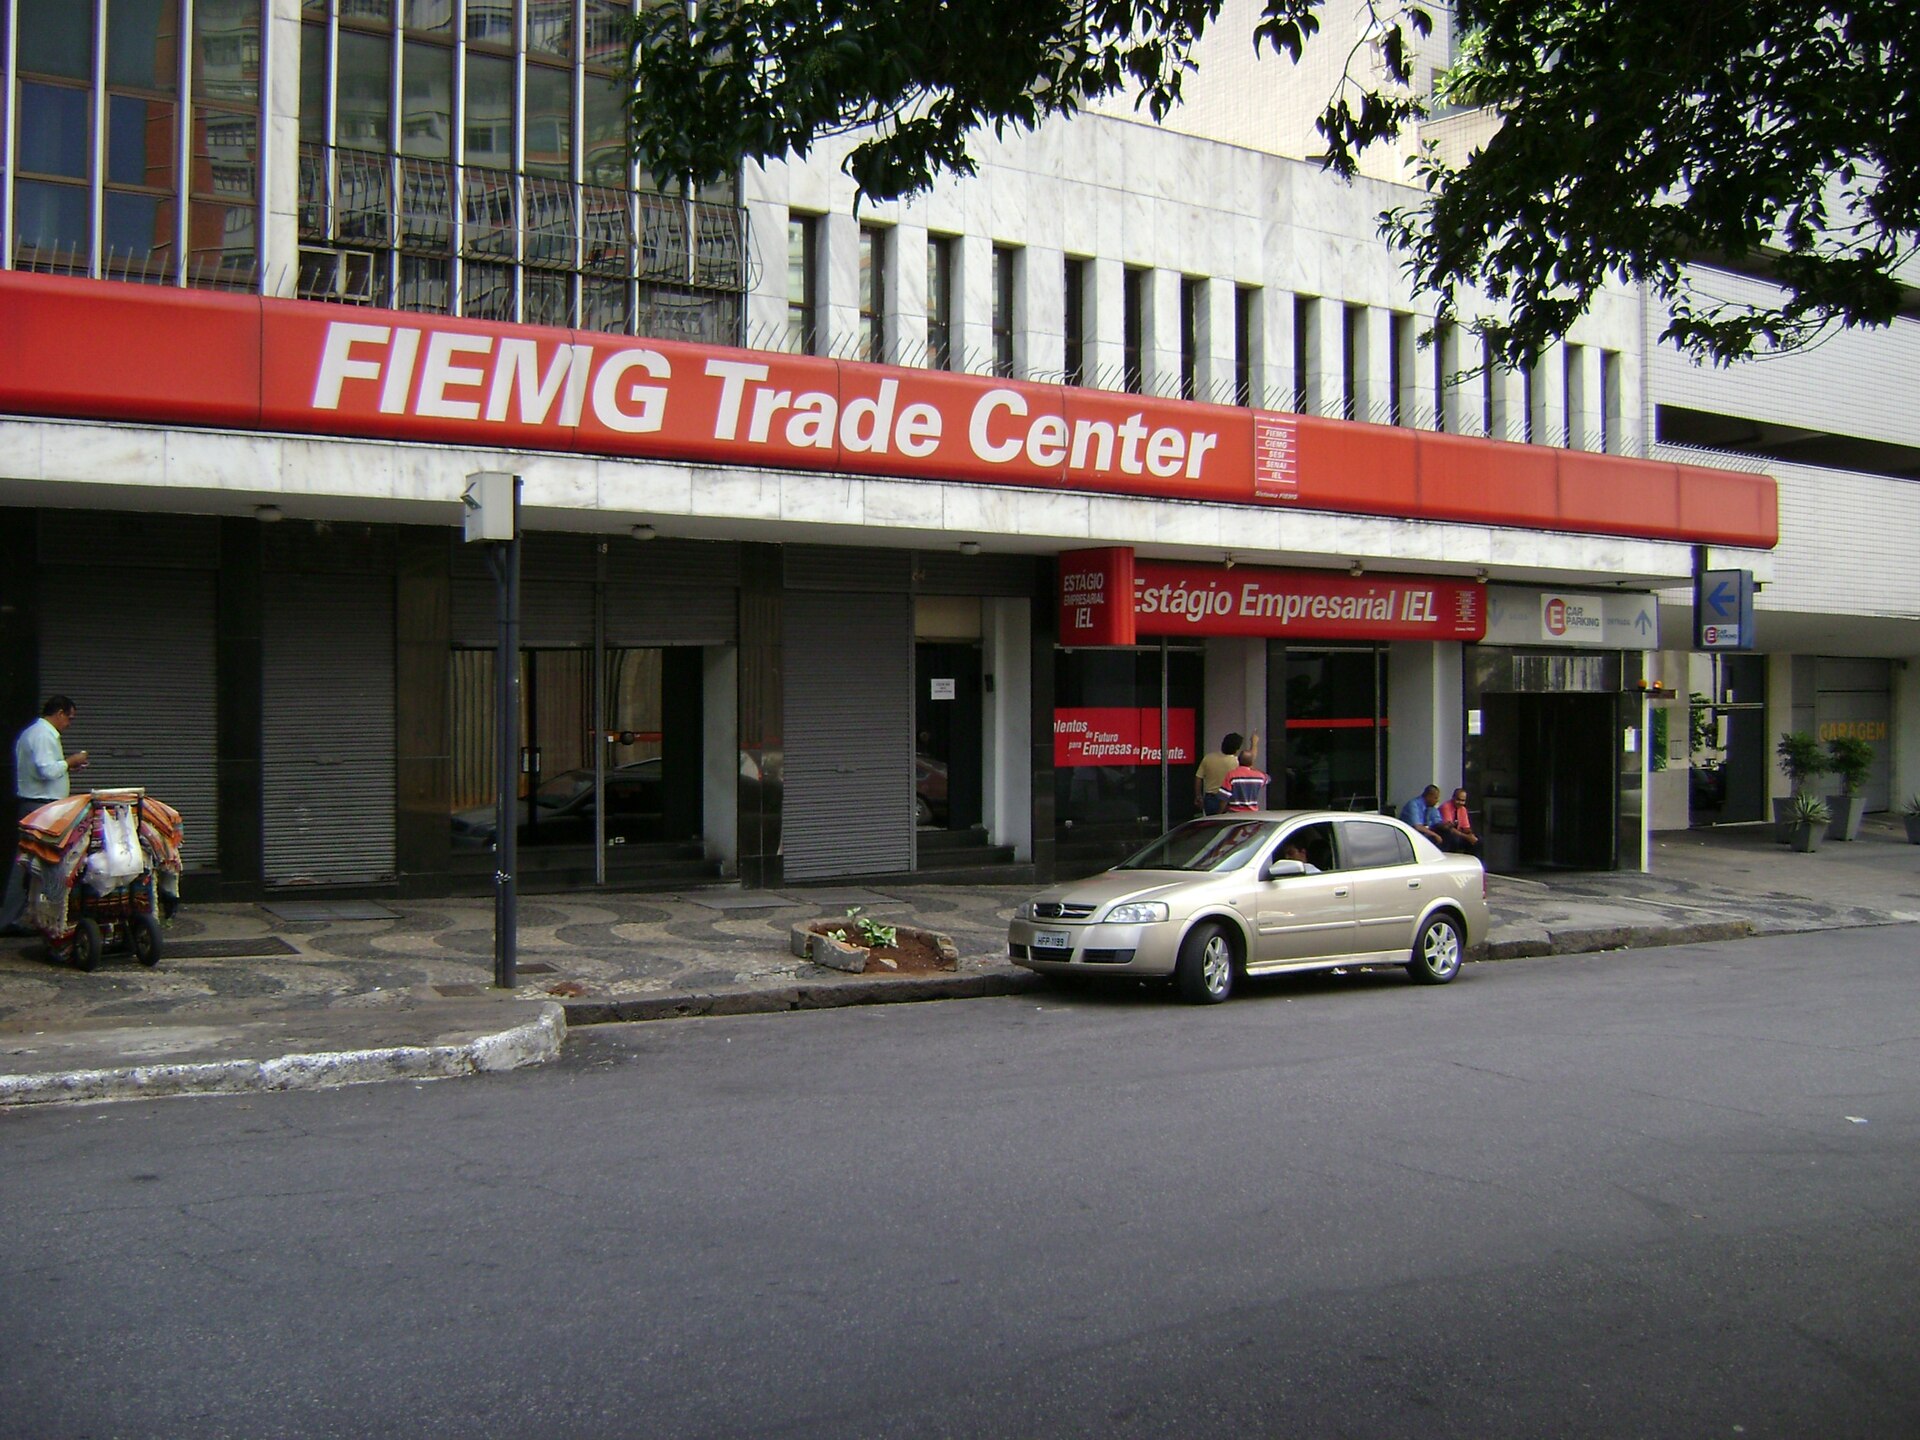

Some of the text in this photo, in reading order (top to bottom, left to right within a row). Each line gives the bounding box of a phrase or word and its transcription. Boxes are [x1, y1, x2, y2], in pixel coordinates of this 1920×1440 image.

[312, 321, 1216, 478] FIEMG Trade Center
[1266, 430, 1287, 438] FIEMG
[1265, 440, 1287, 449] CIEMG
[1268, 450, 1285, 459] SESI
[1266, 461, 1287, 469] SENAI
[1271, 471, 1282, 479] IEL
[1064, 569, 1104, 591] ESTÁGIO
[1064, 592, 1104, 606] EMPRESARIAL
[1134, 578, 1233, 622] Estágio
[1239, 583, 1396, 625] Empresarial
[1401, 591, 1438, 622] IEL
[1566, 606, 1584, 616] CAR
[1075, 607, 1093, 628] IEL
[1566, 617, 1600, 627] PARKING
[1093, 731, 1119, 743] Futuro
[1819, 720, 1886, 742] GARAGEM
[1082, 741, 1132, 758] Empresas
[1140, 746, 1187, 761] Presnte.
